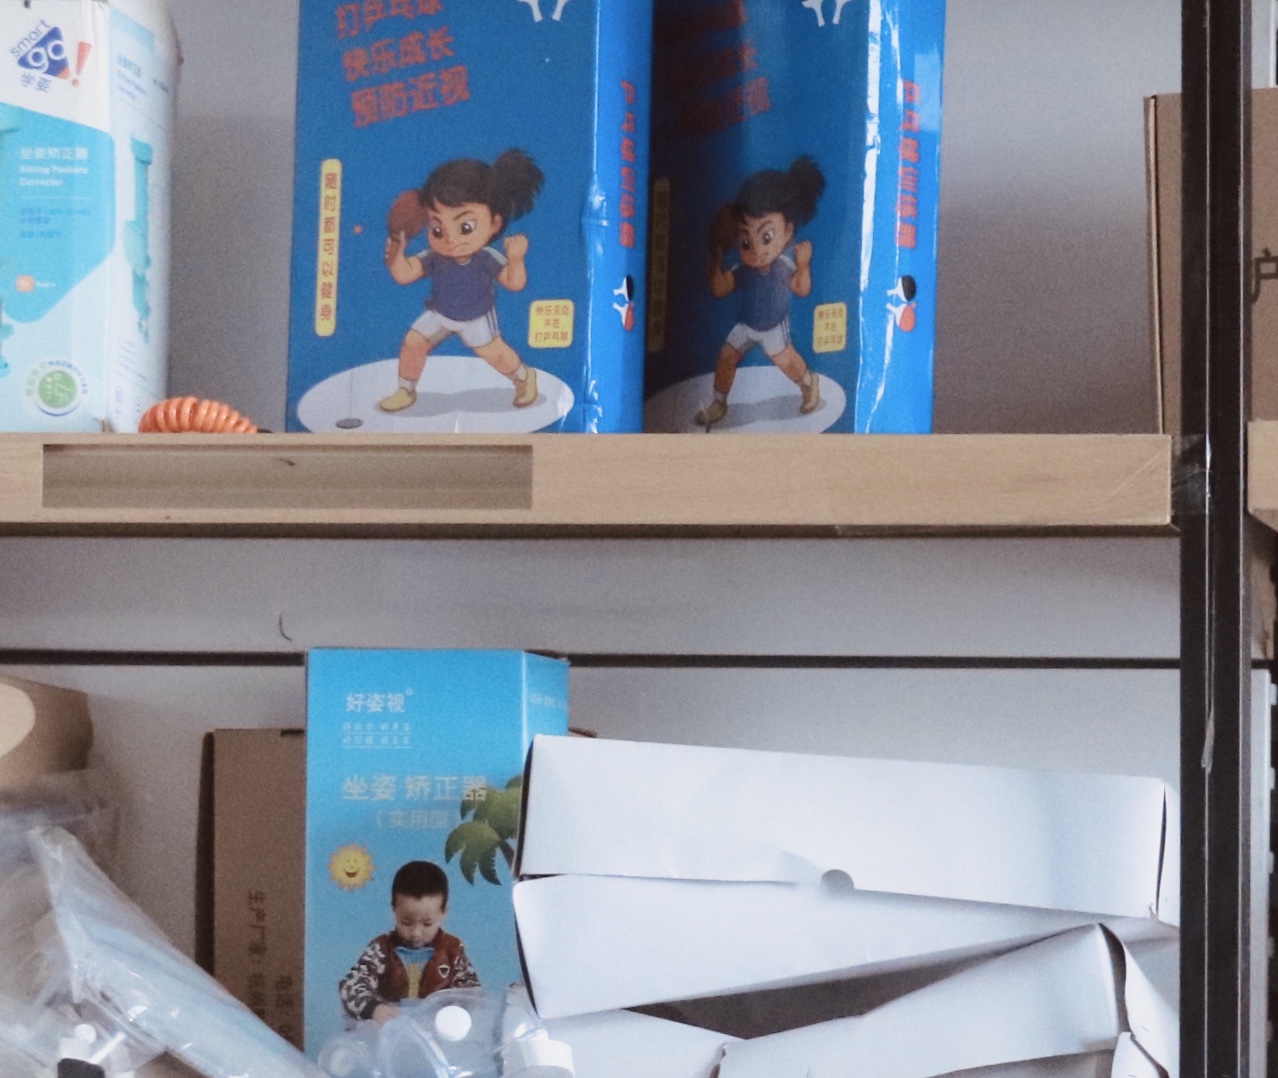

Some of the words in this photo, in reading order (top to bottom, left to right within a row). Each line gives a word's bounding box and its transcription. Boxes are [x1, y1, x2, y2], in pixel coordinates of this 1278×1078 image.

[11, 19, 51, 58] smart
[342, 26, 455, 82] 快乐成长
[351, 65, 471, 128] 预防近视
[342, 775, 397, 801] 坐姿
[405, 775, 488, 801] 矫正器
